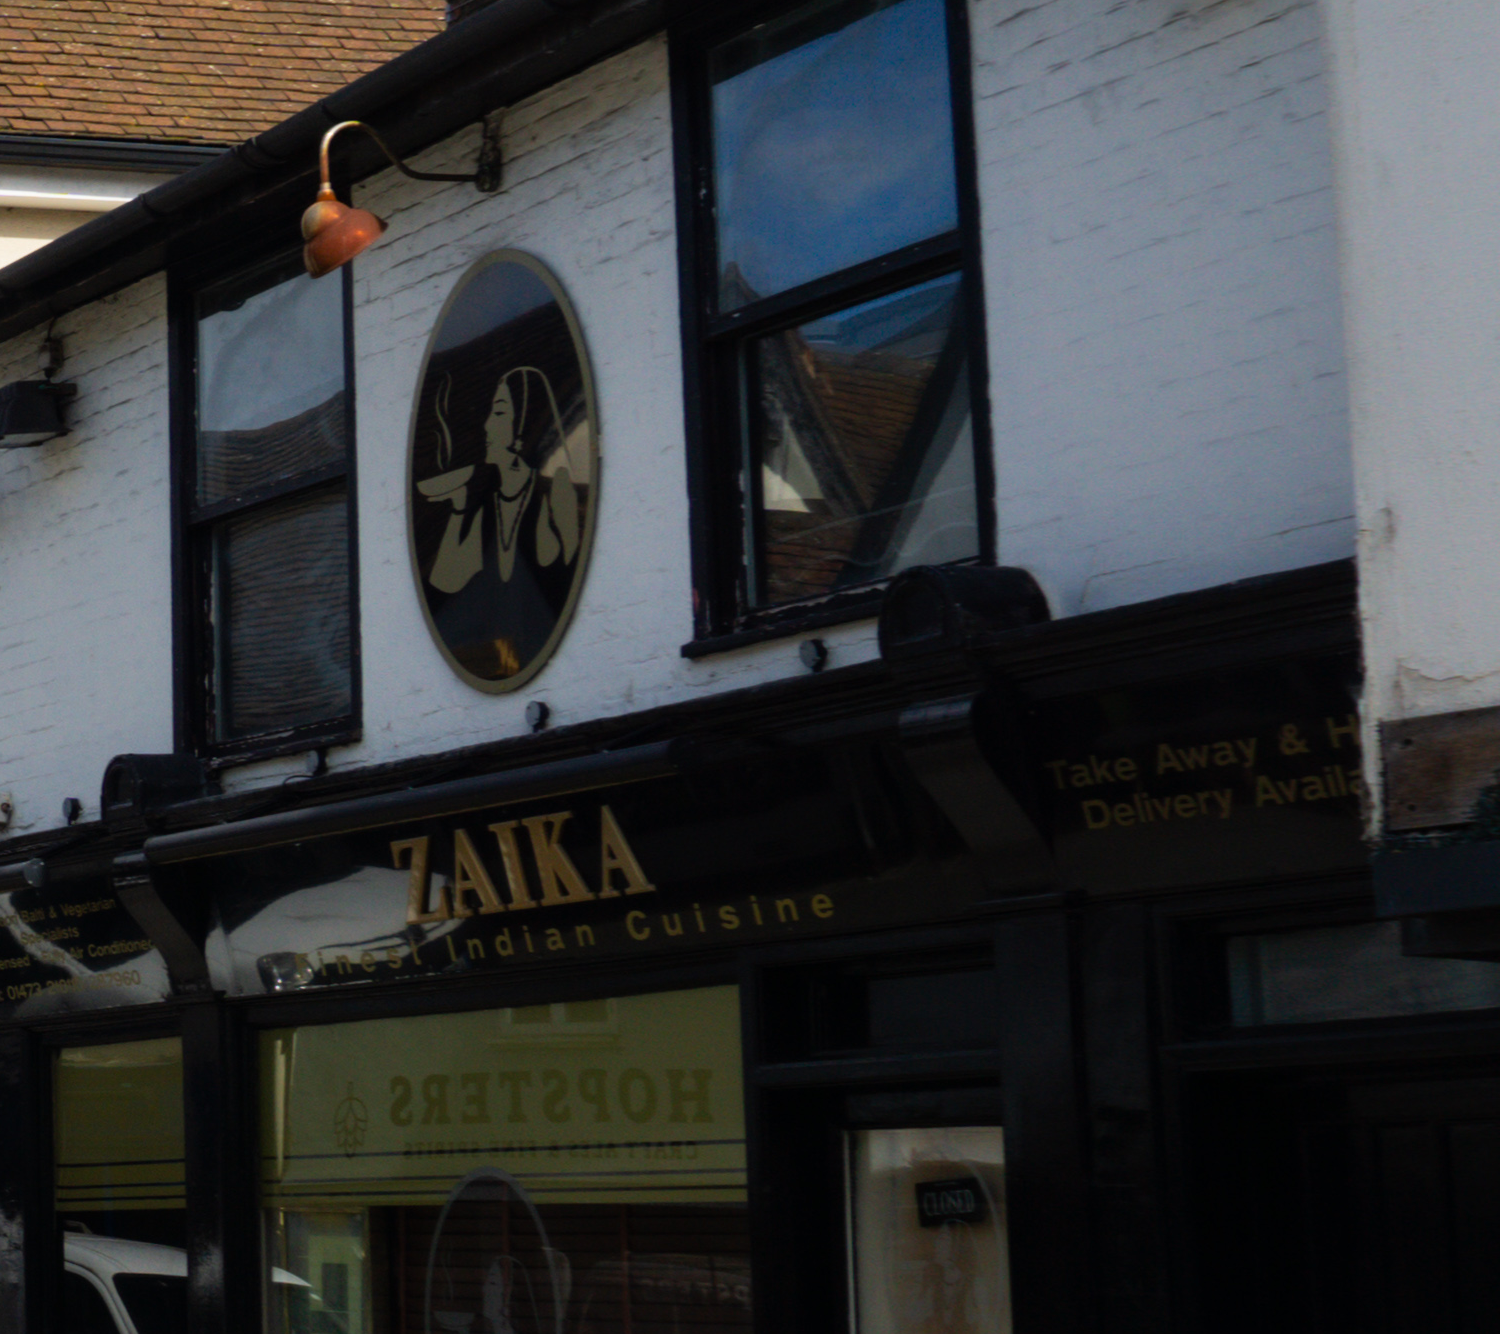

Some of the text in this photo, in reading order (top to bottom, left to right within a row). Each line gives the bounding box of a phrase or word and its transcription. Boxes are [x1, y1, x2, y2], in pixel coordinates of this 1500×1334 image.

[1044, 755, 1138, 790] Take
[1155, 737, 1257, 776] Away
[1279, 723, 1311, 756] &
[1080, 787, 1233, 830] Delivery
[390, 805, 656, 925] ZAIKA
[61, 898, 116, 918] Vegetarian
[447, 923, 596, 961] Indian
[625, 890, 836, 942] Cuisine
[923, 1189, 976, 1216] CLOSED
